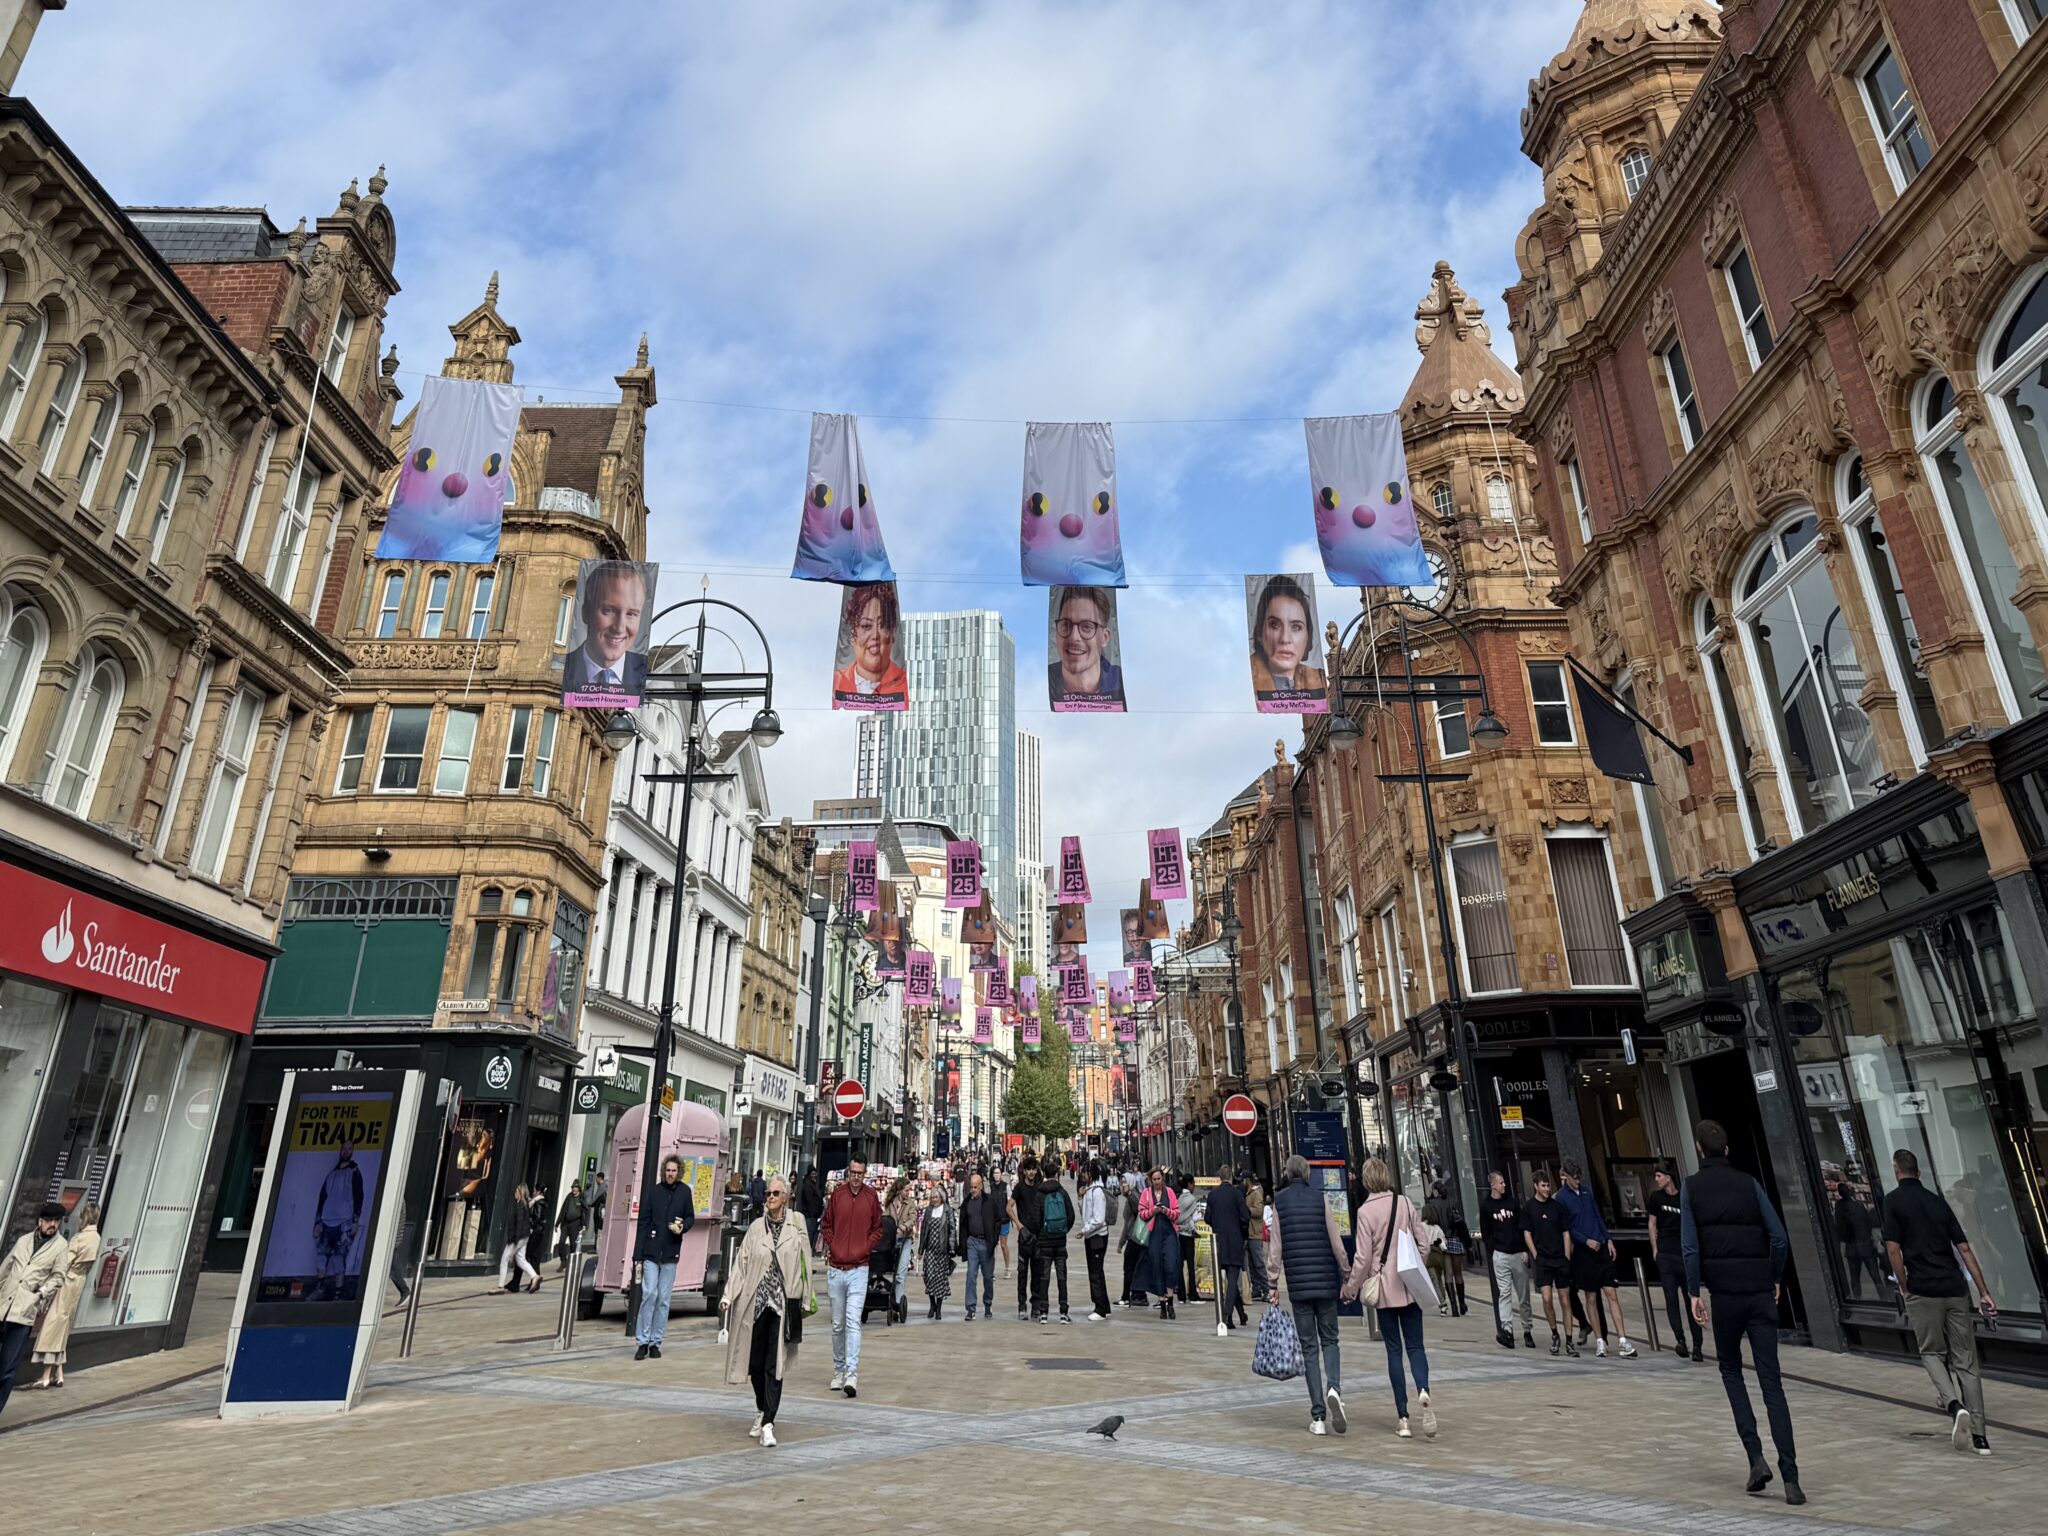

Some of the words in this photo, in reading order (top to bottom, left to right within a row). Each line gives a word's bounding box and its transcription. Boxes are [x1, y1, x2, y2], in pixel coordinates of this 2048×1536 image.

[1157, 865, 1178, 883] 25
[854, 878, 874, 894] 25
[953, 877, 974, 893] 25
[1066, 873, 1083, 890] 25
[1825, 871, 1880, 912] FLANNELS
[75, 921, 181, 994] Santander
[1652, 953, 1686, 983] FLANNELS
[911, 981, 927, 993] 25
[1139, 977, 1149, 990] 25
[991, 986, 1005, 998] 25
[1069, 985, 1085, 997] 25
[441, 1001, 464, 1009] ALBION
[1705, 1014, 1742, 1023] FLANNELS
[978, 1026, 989, 1035] 25
[1026, 1027, 1037, 1036] 25
[1073, 1027, 1084, 1036] 25
[1122, 1024, 1132, 1033] 25
[862, 1027, 870, 1060] ARCADE
[626, 1071, 641, 1093] BANK
[760, 1071, 788, 1102] OFFICE
[1503, 1080, 1548, 1092] OODLES
[301, 1106, 329, 1120] FOR
[333, 1106, 359, 1119] THE
[300, 1121, 382, 1146] TRADE
